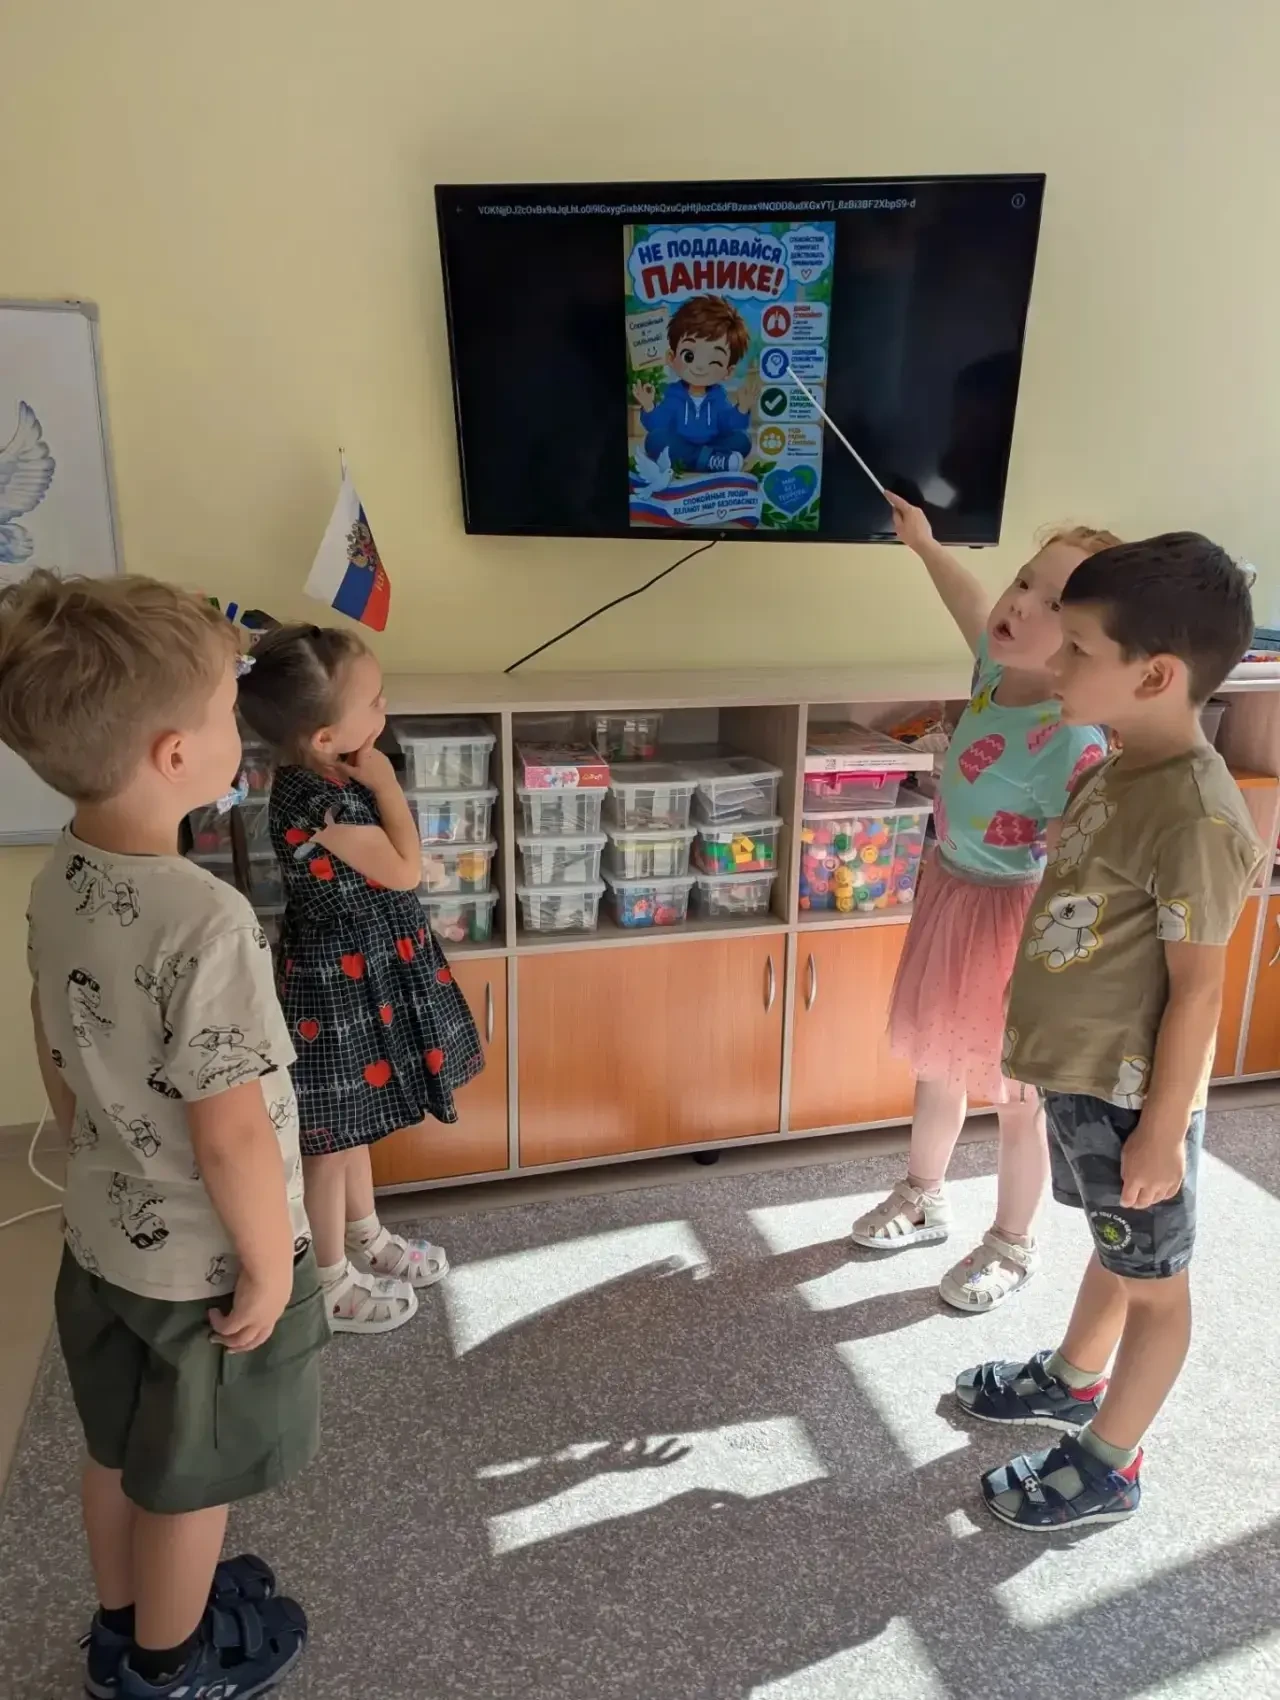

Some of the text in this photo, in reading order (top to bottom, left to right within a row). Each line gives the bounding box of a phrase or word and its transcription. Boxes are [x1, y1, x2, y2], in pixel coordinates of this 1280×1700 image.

[638, 238, 782, 265] НЕ ПОДДАВАЙСЯ
[641, 261, 785, 299] ПАНИКЕ!
[683, 491, 725, 506] СПОКОЙНЫЕ
